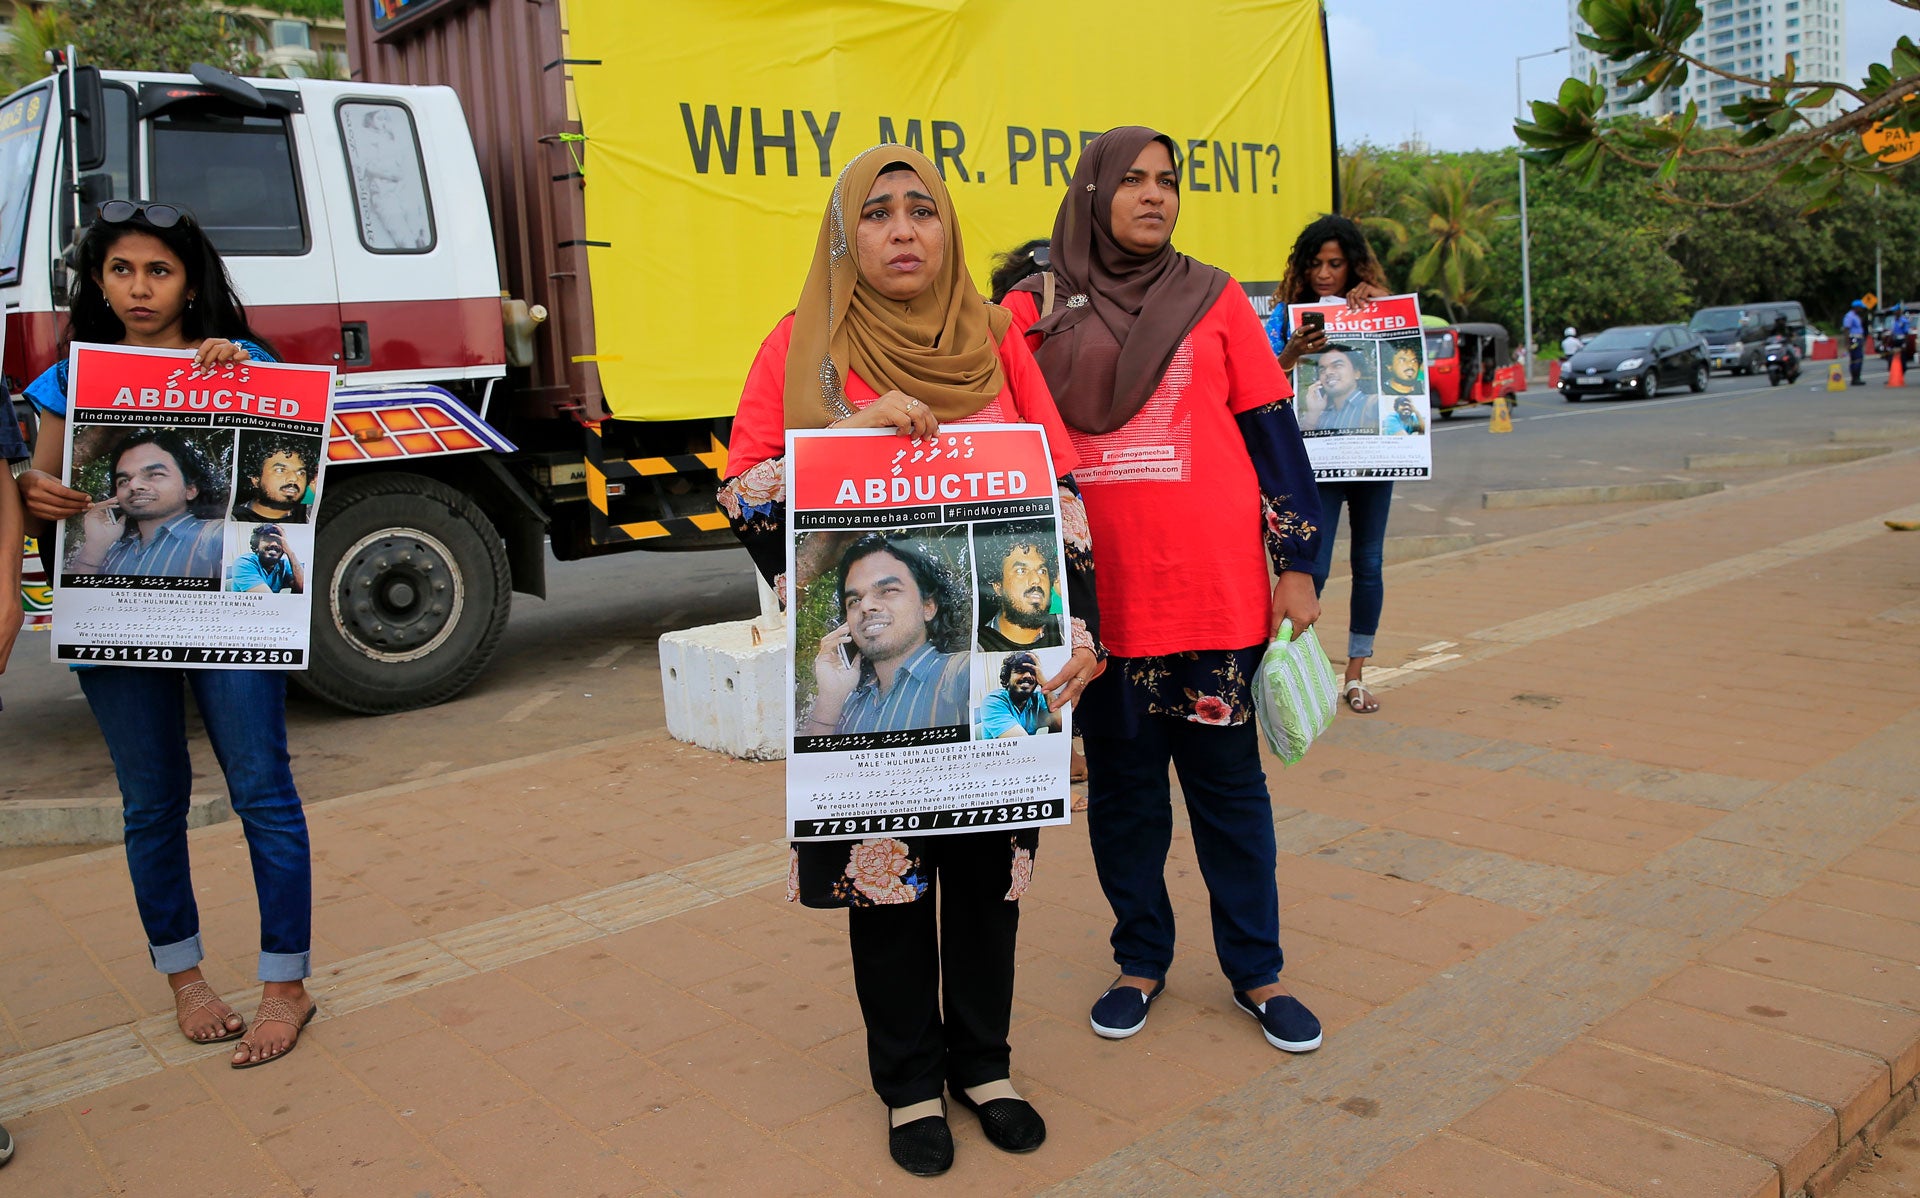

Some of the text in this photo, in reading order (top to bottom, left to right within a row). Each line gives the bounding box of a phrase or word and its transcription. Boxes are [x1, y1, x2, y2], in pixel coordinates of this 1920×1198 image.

[679, 102, 1281, 194] WHY MR. PRENT?
[1325, 315, 1406, 331] BDUCTED
[112, 387, 300, 417] ABDUCTED
[80, 412, 206, 424] findmoyameehaa.com
[217, 415, 320, 433] #FindMoyameehaa
[1106, 449, 1170, 460] #findmoyameehaa
[1075, 465, 1179, 479] www.findmoyameehaa.com
[1313, 469, 1357, 478] 791120
[1371, 468, 1423, 477] 7773250
[834, 470, 1027, 505] ABDUCTED
[801, 510, 936, 525] findmoyameehaa.com
[948, 502, 1050, 518] #FindMoyameehaa
[74, 647, 293, 663] 7791120 / 7773250
[850, 753, 871, 761] LAST
[874, 751, 896, 759] SEEN
[923, 746, 955, 755] AUGUST
[958, 744, 976, 752] 2014
[986, 741, 1018, 750] 12:45AM
[942, 754, 967, 762] FERRY
[971, 750, 1010, 759] TERMINAL
[830, 803, 858, 811] request
[861, 801, 887, 809] anyone
[907, 798, 921, 806] may
[943, 795, 955, 803] any
[957, 791, 998, 799] information
[1001, 787, 1034, 797] regarding
[830, 808, 877, 817] whereabouts
[970, 799, 1000, 807] Rilwan's
[1002, 796, 1023, 805] family
[813, 803, 1053, 835] 7791120 / 7773250
